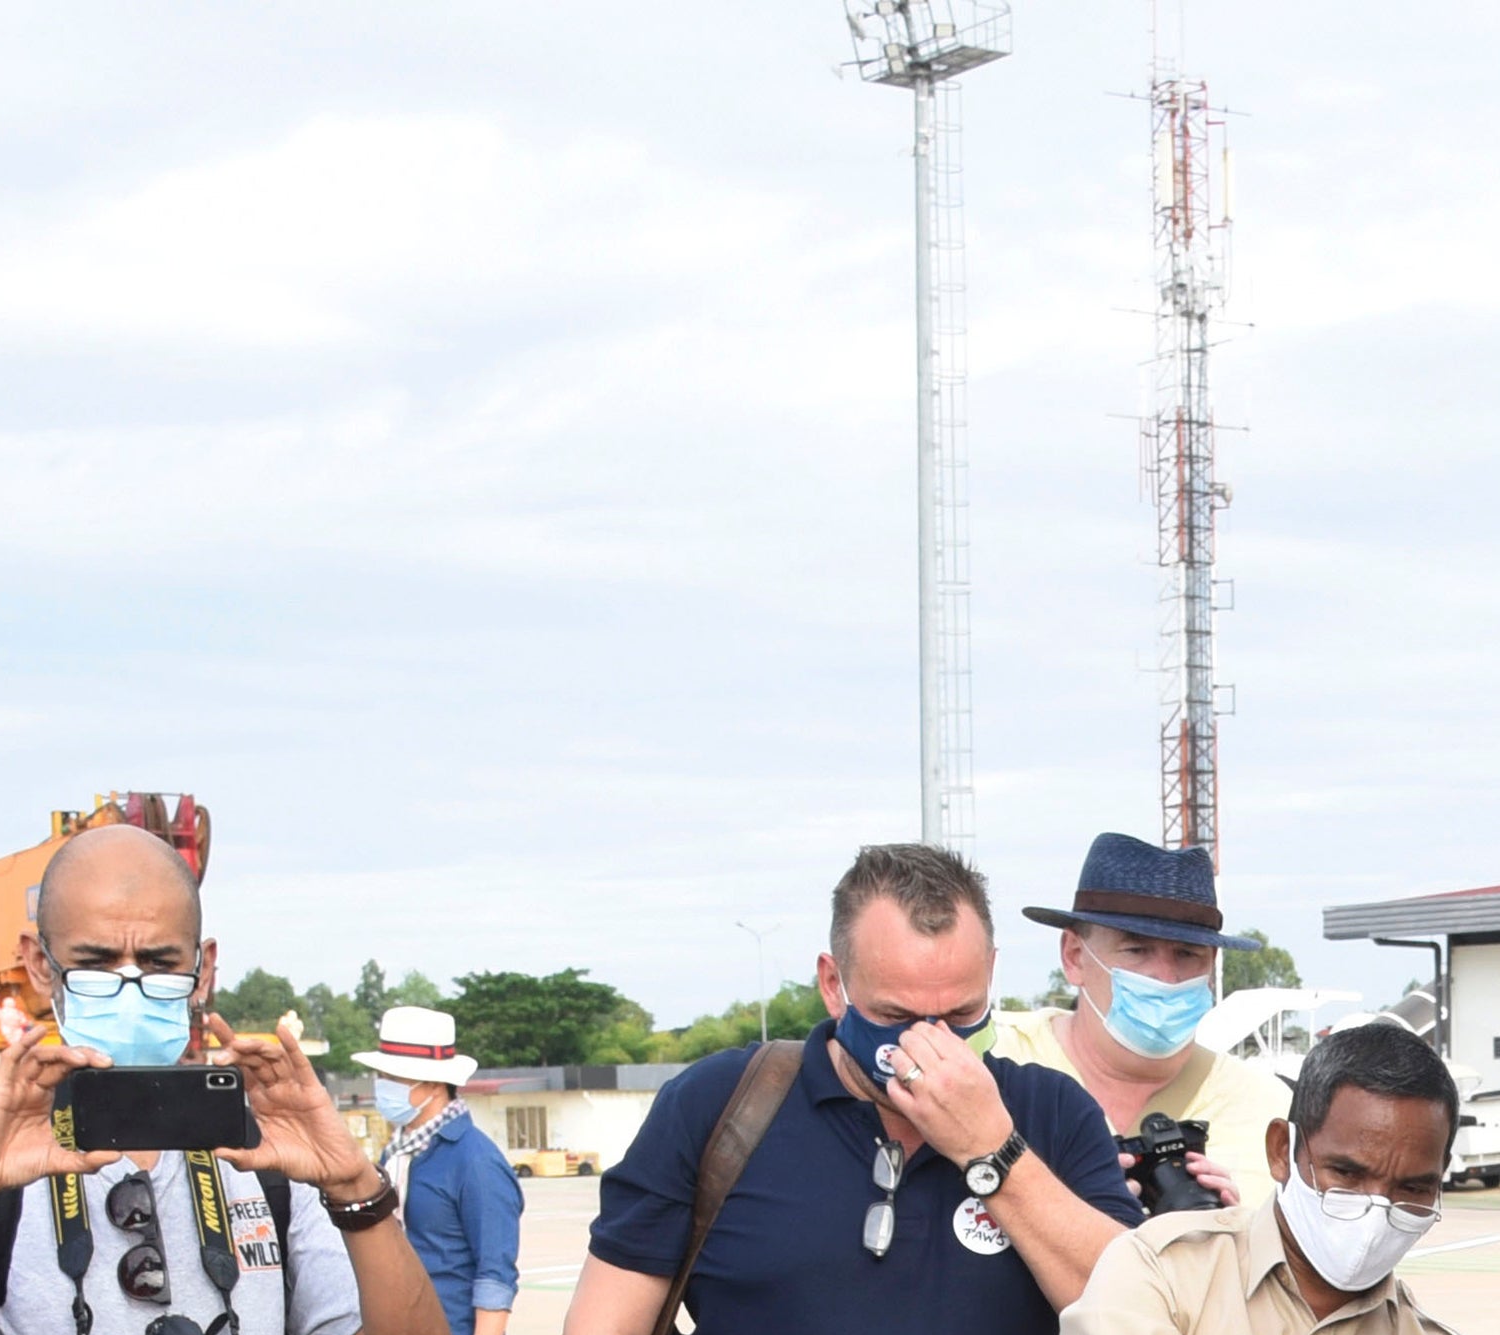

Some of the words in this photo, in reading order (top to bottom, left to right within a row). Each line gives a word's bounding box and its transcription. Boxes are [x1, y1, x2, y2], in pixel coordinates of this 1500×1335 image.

[1155, 1142, 1185, 1154] LEICA
[62, 1173, 79, 1220] Niko
[198, 1171, 222, 1234] Nikon
[228, 1201, 262, 1224] FREE
[238, 1241, 282, 1268] WILD
